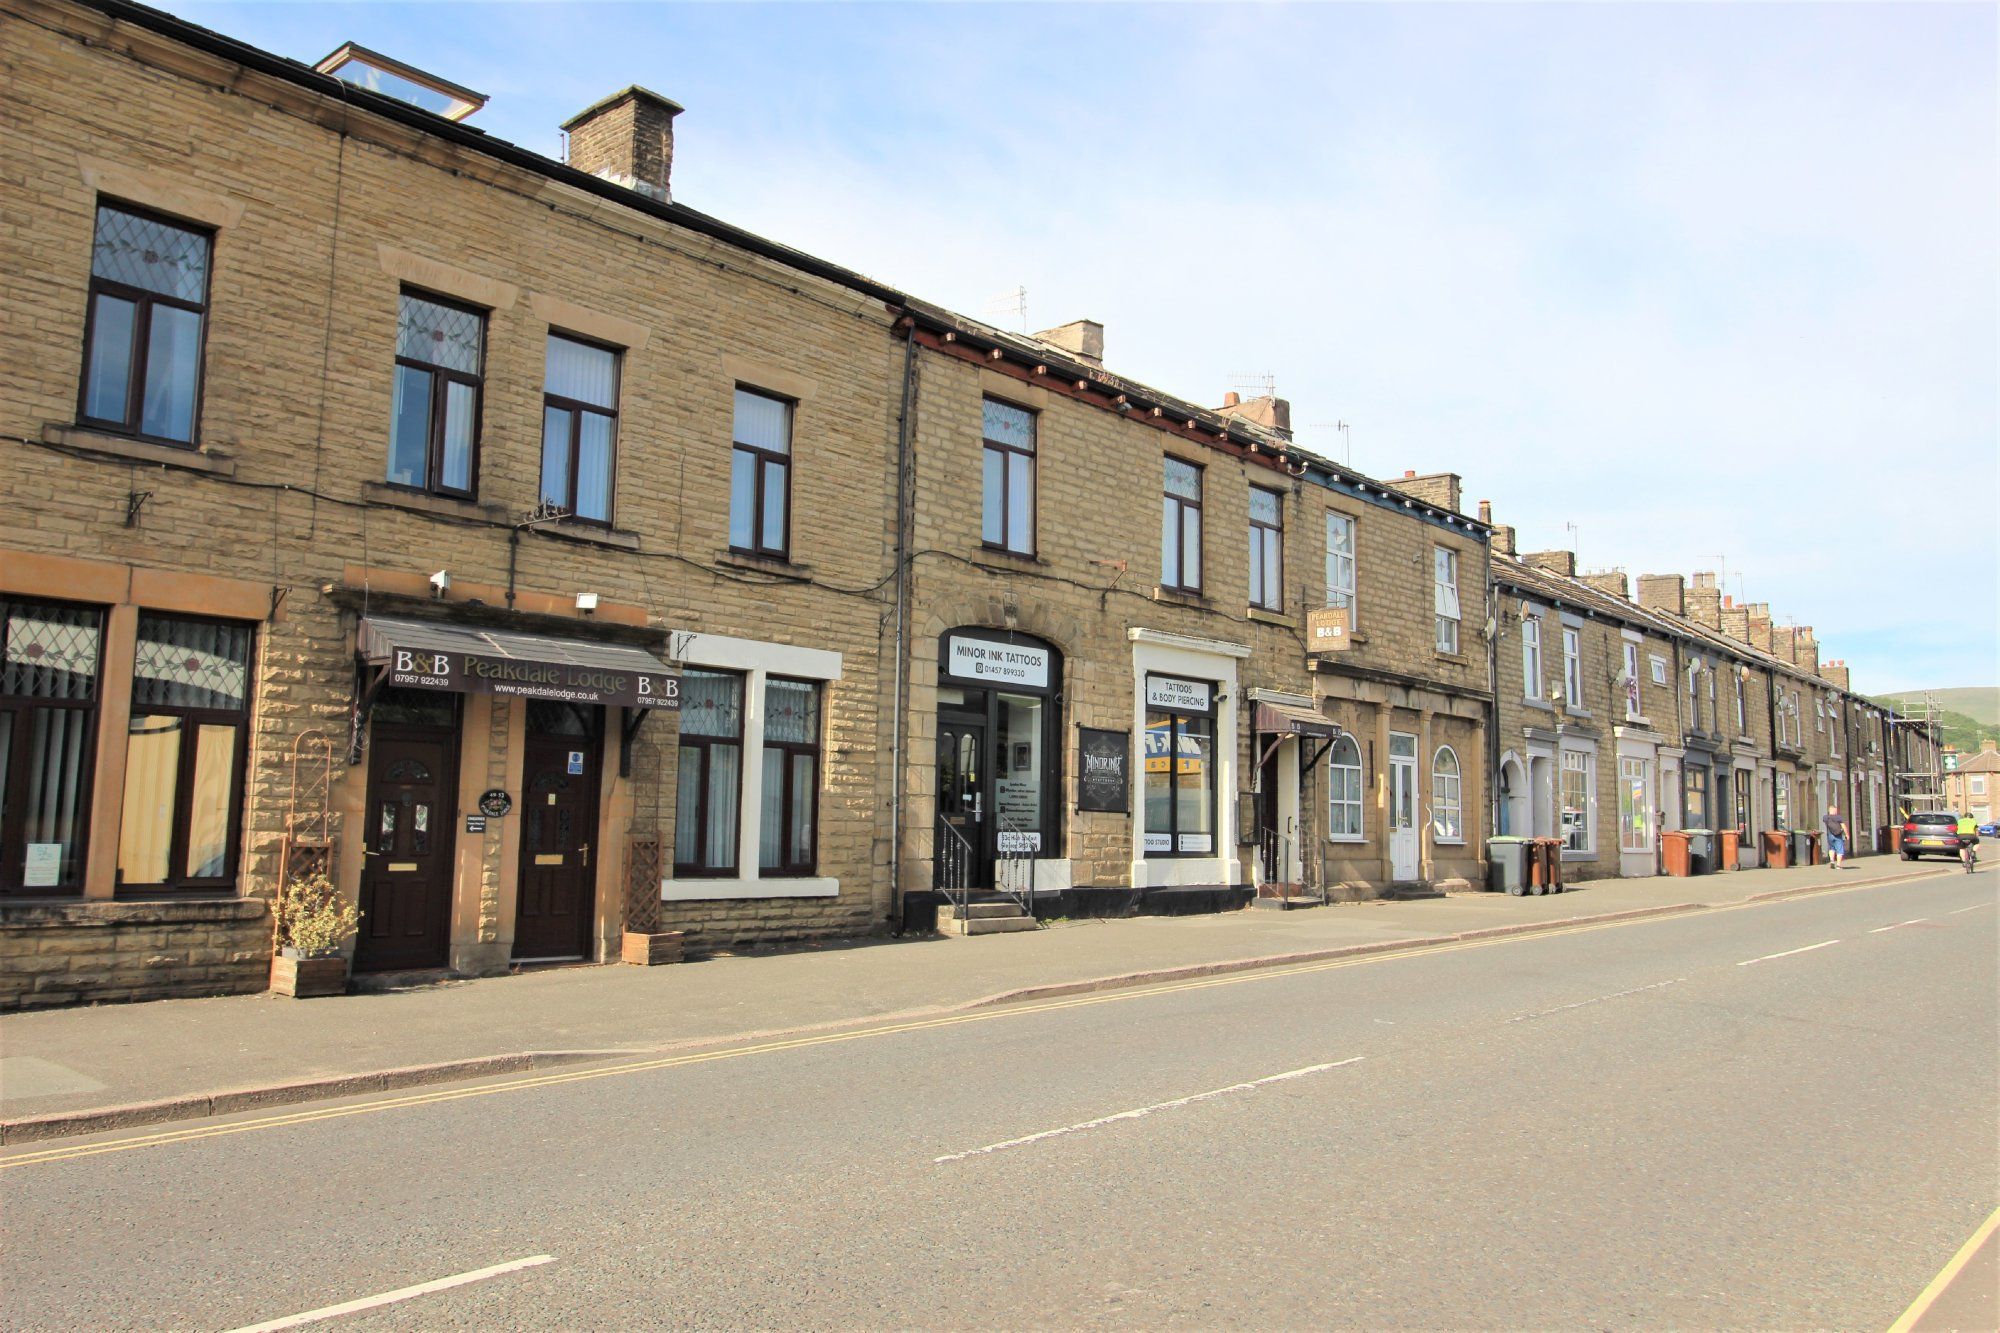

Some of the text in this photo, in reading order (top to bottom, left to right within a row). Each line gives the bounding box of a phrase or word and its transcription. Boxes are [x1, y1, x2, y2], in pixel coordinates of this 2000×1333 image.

[1316, 626, 1341, 638] B&B
[396, 650, 450, 675] B&B
[957, 645, 1042, 667] MINOR INK TATTOOS
[463, 656, 627, 695] Peakdale Lodge
[985, 665, 1001, 673] 01457
[395, 674, 449, 686] 07957 922439
[638, 676, 679, 697] B&B
[495, 684, 599, 700] www.peakdalelodge.co.uk
[1166, 682, 1193, 694] TATTOOS
[637, 697, 679, 707] 07957 922439
[1152, 692, 1205, 706] & BODY PIERCING
